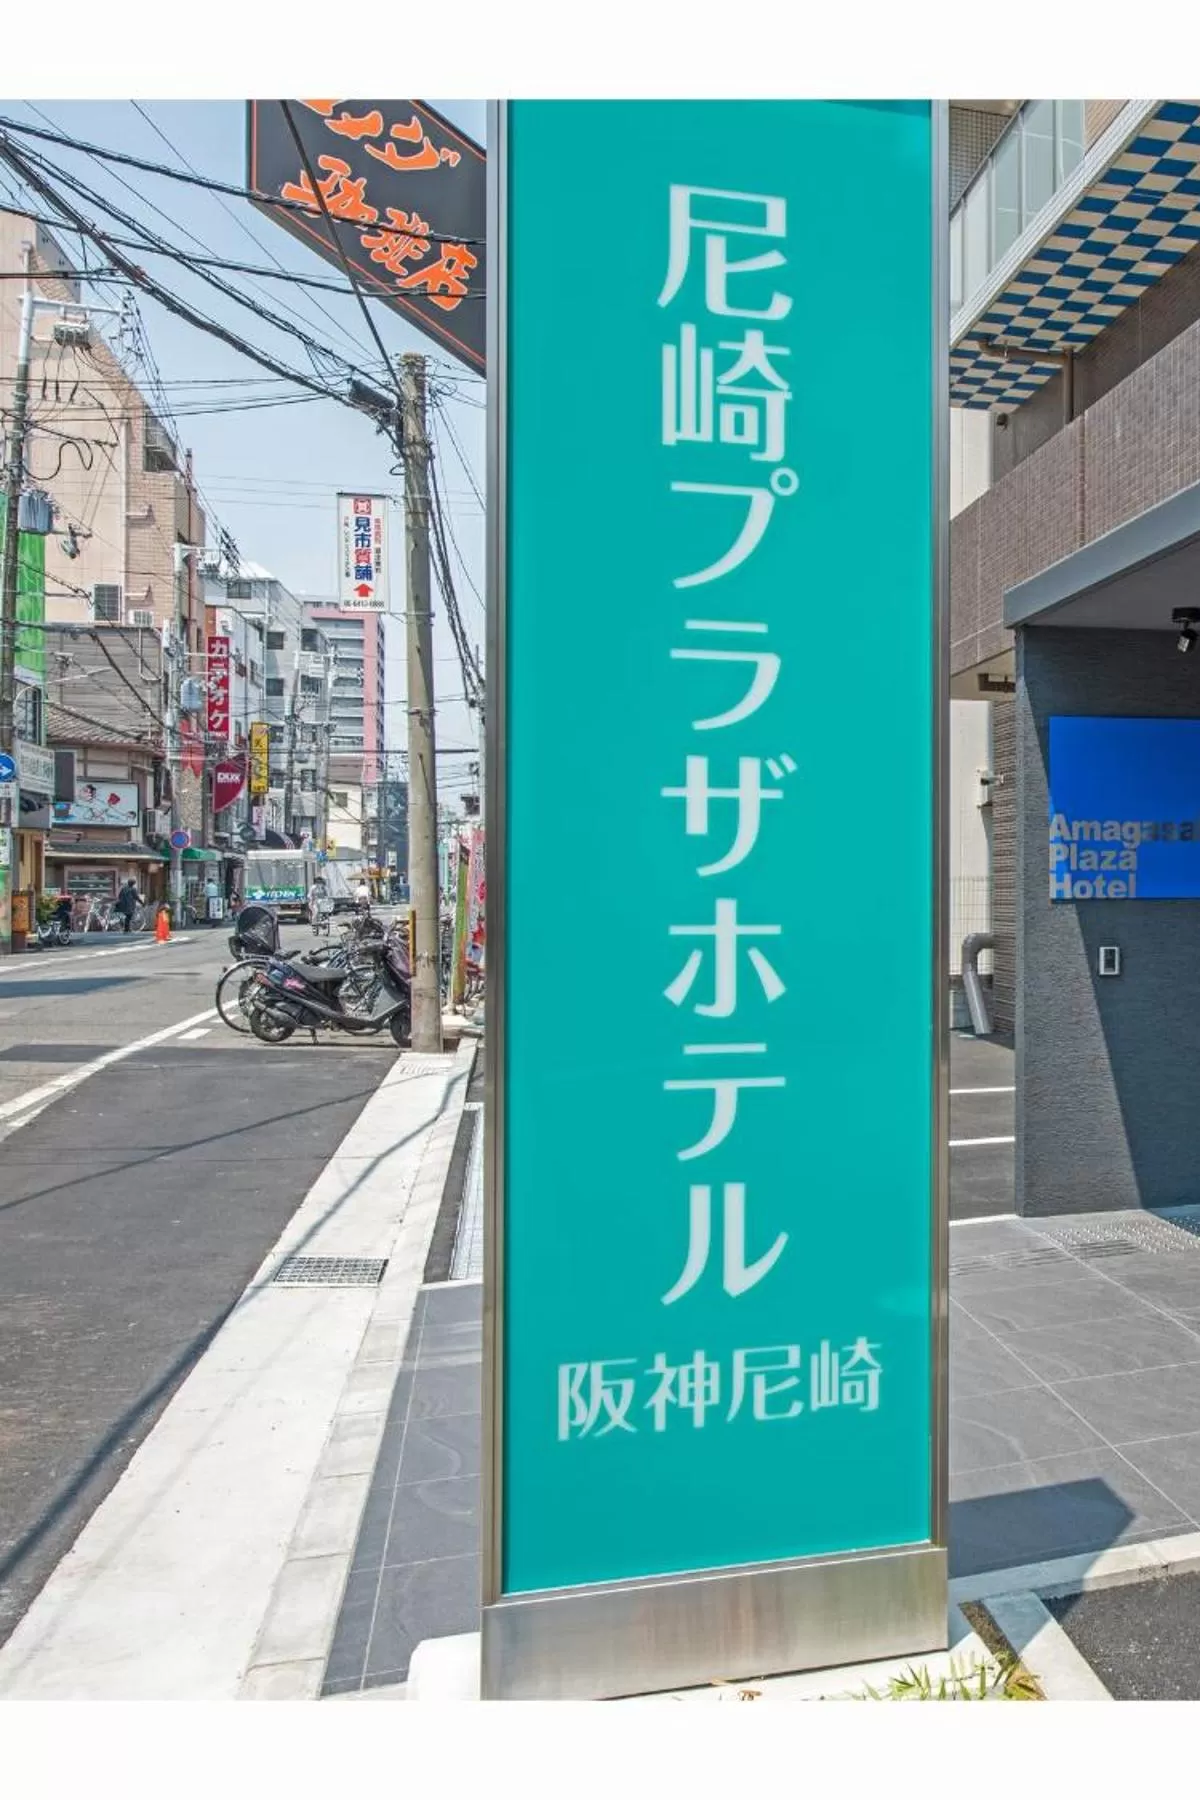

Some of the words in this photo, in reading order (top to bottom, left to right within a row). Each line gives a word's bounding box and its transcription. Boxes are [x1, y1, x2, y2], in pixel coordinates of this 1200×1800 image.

[658, 185, 798, 1304] 尼崎プラザホテル
[1050, 843, 1137, 871] Plaza
[1050, 873, 1137, 898] Hotel
[558, 1338, 882, 1441] 阪神尼崎
